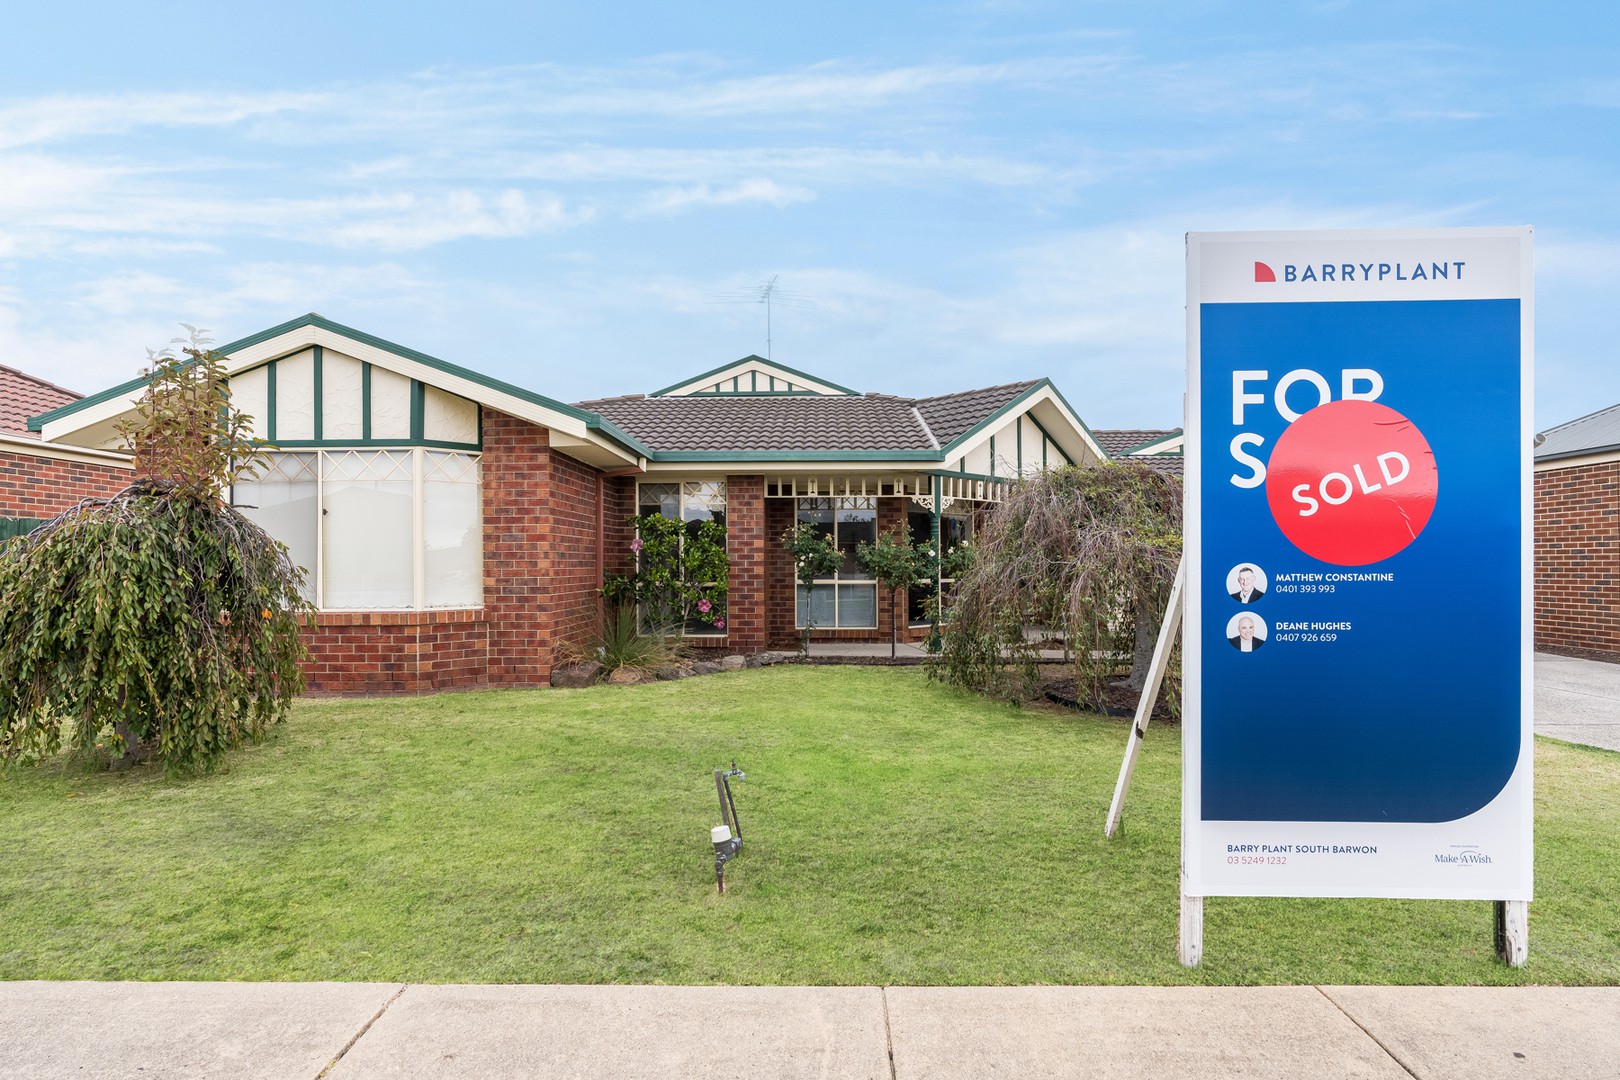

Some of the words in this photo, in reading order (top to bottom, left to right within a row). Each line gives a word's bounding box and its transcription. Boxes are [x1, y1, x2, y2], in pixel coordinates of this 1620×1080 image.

[1291, 451, 1410, 517] SOLD
[1275, 573, 1324, 582] MATTHEW
[1325, 573, 1394, 582] CONSTANTINE
[1275, 584, 1298, 594] 0401
[1300, 584, 1317, 594] 393
[1318, 584, 1336, 594] 993
[1275, 622, 1309, 631] DEANE
[1311, 622, 1352, 631] HUGHES
[1275, 633, 1300, 642] 0407
[1301, 633, 1319, 642] 926
[1320, 633, 1338, 642] 659
[1227, 844, 1260, 853] BARRY
[1262, 844, 1293, 853] PLANT
[1295, 845, 1330, 854] SOUTH
[1332, 845, 1378, 855] BARWON
[1227, 856, 1240, 865] 03
[1241, 856, 1265, 865] 5249
[1266, 856, 1287, 865] 1232
[1434, 854, 1459, 863] Make
